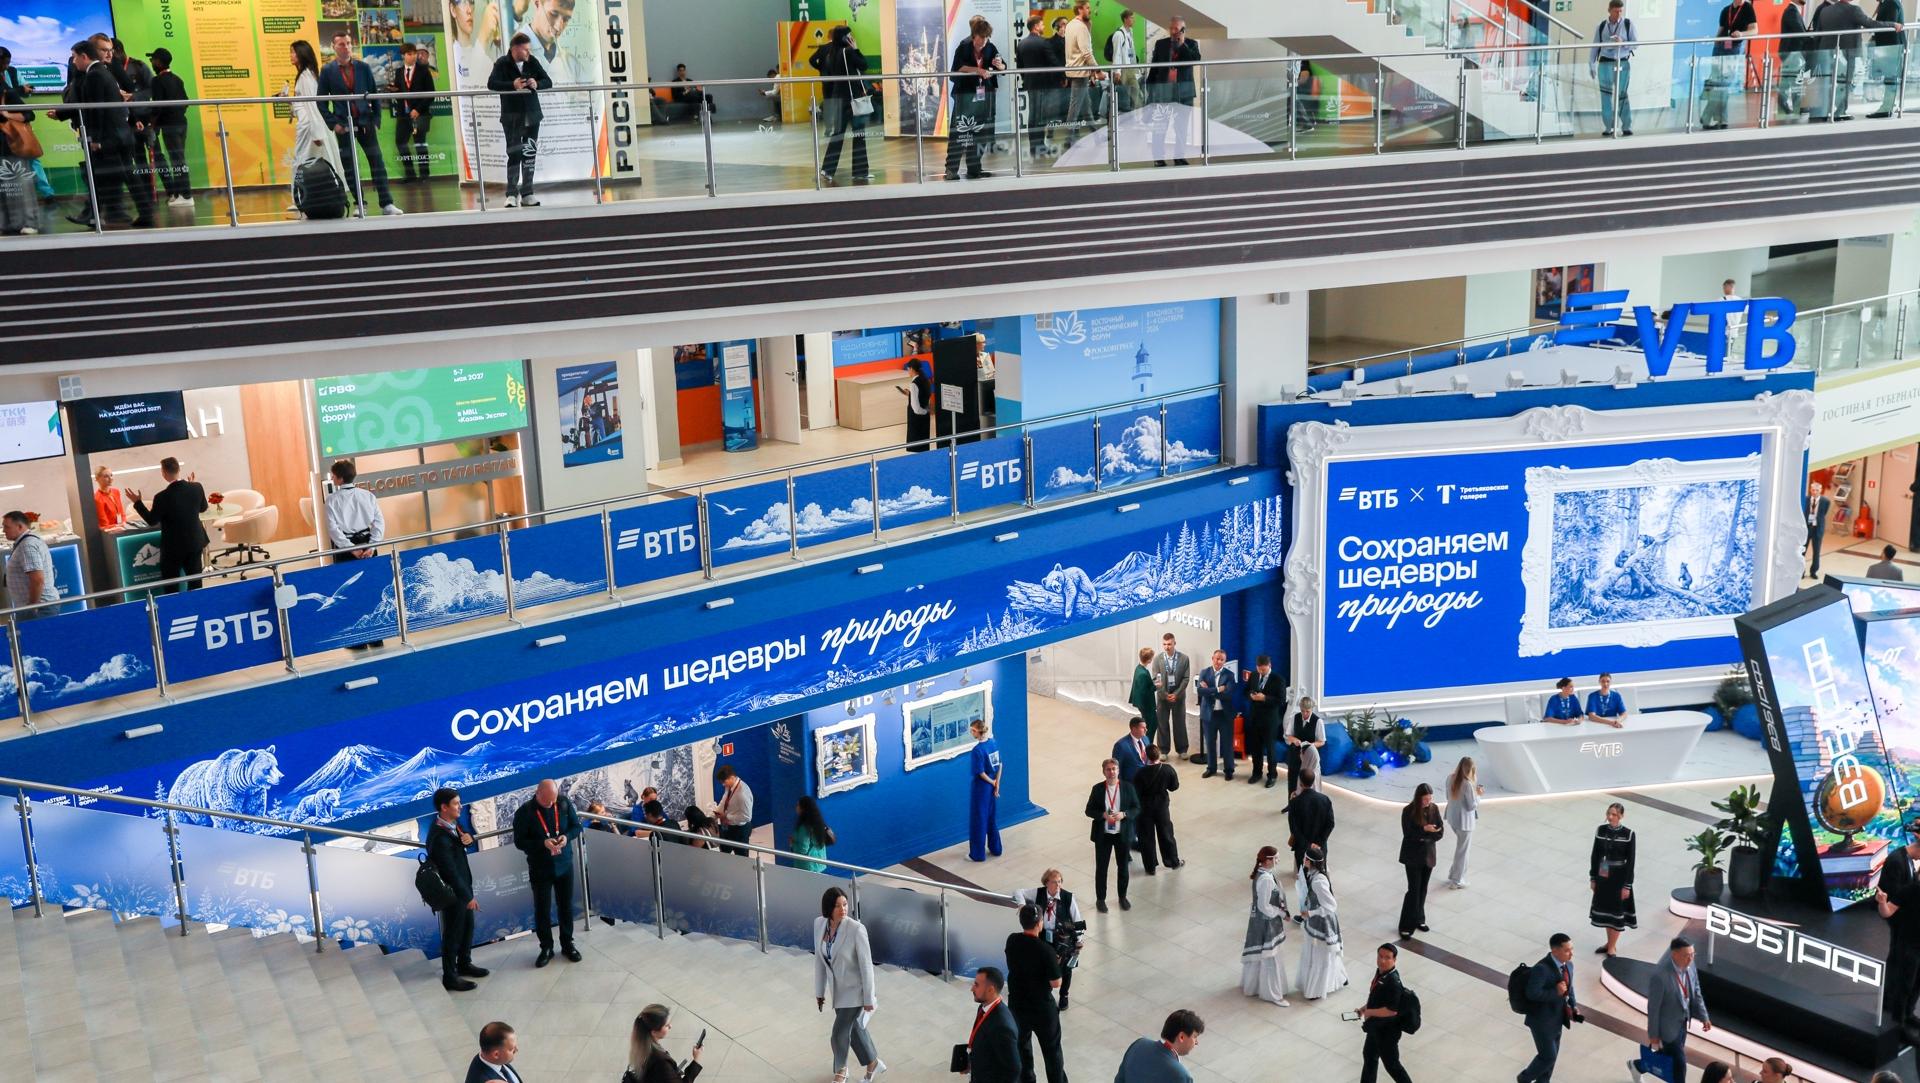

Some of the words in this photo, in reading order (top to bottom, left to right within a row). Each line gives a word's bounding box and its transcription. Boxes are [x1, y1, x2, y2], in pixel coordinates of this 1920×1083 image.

[1633, 297, 1796, 376] VTB
[328, 384, 356, 395] РВФ
[108, 408, 146, 417] KAZANFORUM
[321, 404, 356, 413] Казань
[322, 412, 356, 423] форум
[1823, 400, 1871, 422] ГОСТИНАЯ
[110, 423, 155, 434] KAZANFORUM.RU
[419, 470, 438, 485] TO
[441, 457, 517, 481] TATARSTAN
[981, 458, 1022, 489] ВТБ
[1359, 489, 1398, 510] ВТБ
[1460, 484, 1509, 493] Третьяковская
[644, 524, 696, 559] ВТБ
[1338, 531, 1509, 563] Сохраняем
[1338, 560, 1477, 589] шедевры
[1170, 609, 1212, 632] РОССЕТИ
[1337, 591, 1483, 632] природы
[204, 609, 273, 650] ВТБ
[451, 672, 649, 741] Сохраняем
[663, 634, 806, 689] шедевры
[821, 599, 956, 664] природы
[1593, 742, 1624, 759] VTB
[234, 868, 277, 889] ВТБ
